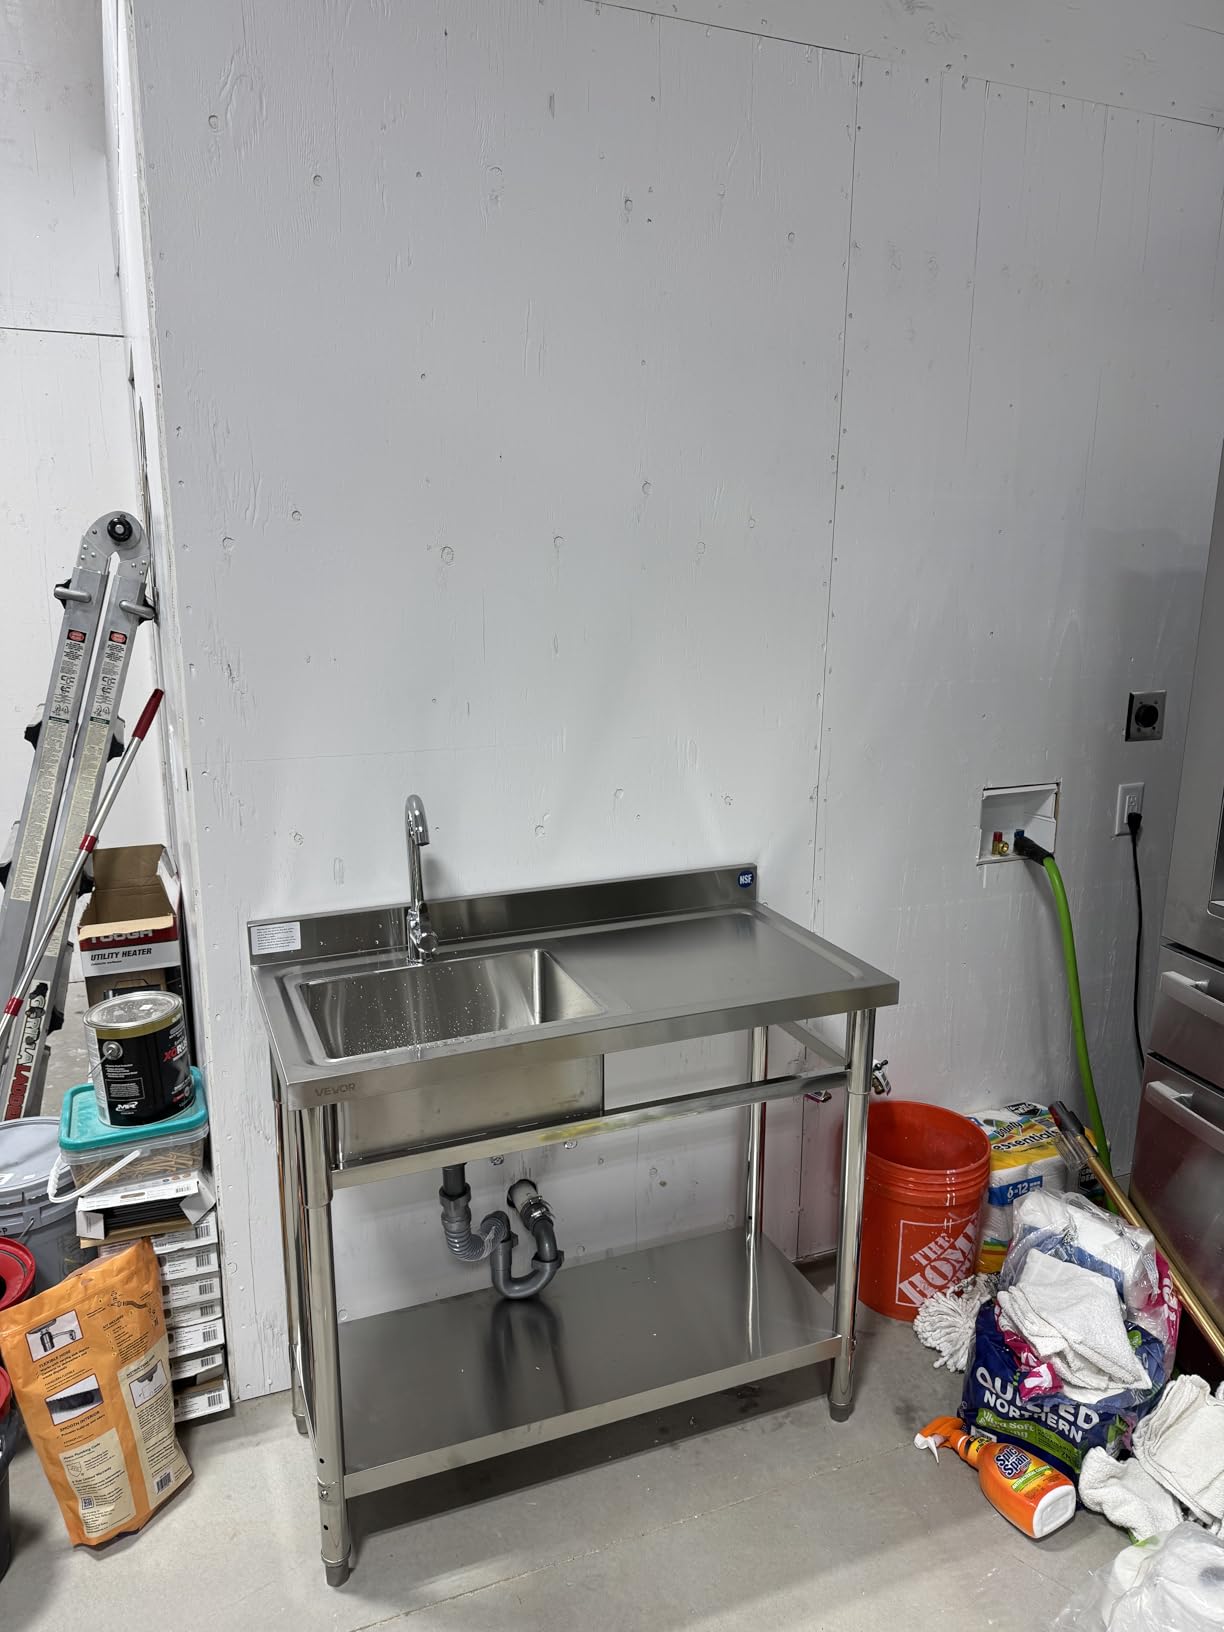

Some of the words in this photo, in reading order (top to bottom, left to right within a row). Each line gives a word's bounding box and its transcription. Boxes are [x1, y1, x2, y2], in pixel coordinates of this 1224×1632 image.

[739, 873, 753, 885] NSF
[90, 951, 120, 962] UTILITY
[121, 947, 153, 958] HEATER
[314, 1082, 356, 1097] VEVOR
[992, 1128, 1059, 1152] essentials
[910, 1232, 954, 1266] THE
[898, 1222, 977, 1306] HOME
[976, 1366, 1100, 1430] QULED
[983, 1389, 1083, 1443] NORTHERN
[1008, 1421, 1036, 1432] Soft
[995, 1446, 1017, 1467] Spic
[1003, 1454, 1030, 1477] Span
